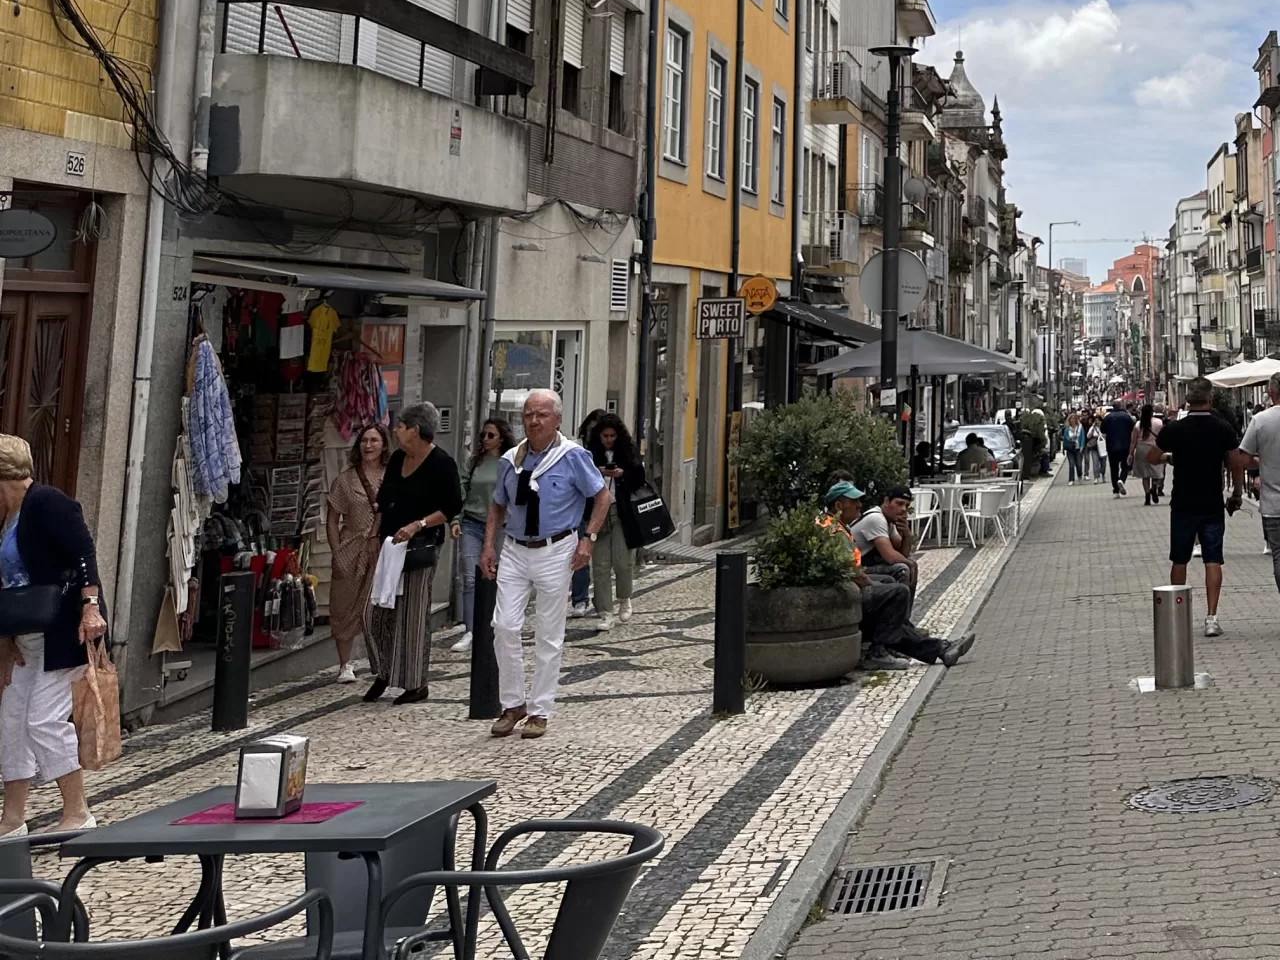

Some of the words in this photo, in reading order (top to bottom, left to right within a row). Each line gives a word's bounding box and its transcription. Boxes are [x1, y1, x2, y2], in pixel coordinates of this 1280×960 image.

[67, 155, 85, 173] 526
[173, 288, 187, 301] 524
[702, 303, 740, 318] SWEET
[701, 317, 739, 337] PORTO
[370, 327, 400, 353] ATM
